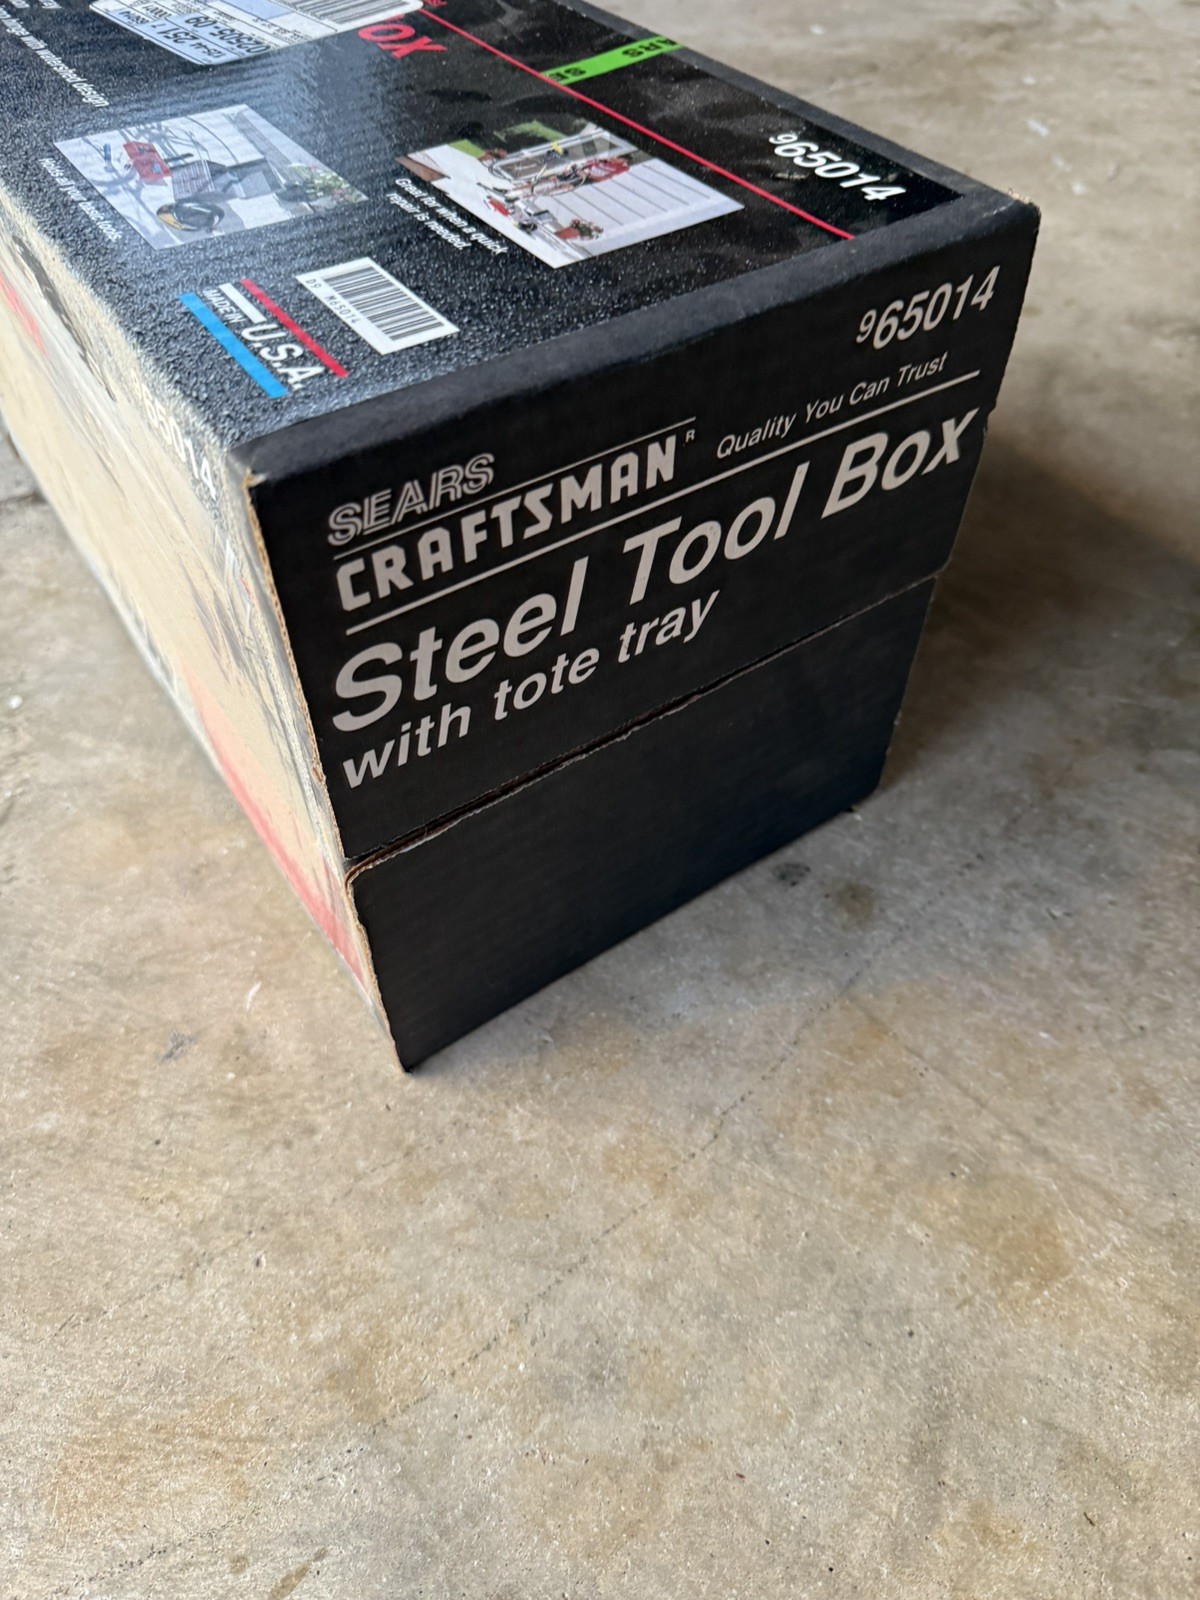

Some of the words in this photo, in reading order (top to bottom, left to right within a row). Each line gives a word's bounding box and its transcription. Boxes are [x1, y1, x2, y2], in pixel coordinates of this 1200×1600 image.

[21, 35, 48, 50] with
[35, 49, 88, 83] watershed
[72, 82, 109, 107] design
[357, 15, 447, 59] OX
[38, 157, 64, 177] Holds
[55, 176, 76, 188] all
[59, 186, 88, 202] your
[768, 131, 908, 203] 965014
[79, 200, 105, 222] basic
[386, 190, 421, 214] repair
[414, 211, 430, 222] is
[425, 220, 472, 251] needed.
[395, 178, 428, 198] Great
[420, 196, 441, 209] for
[436, 207, 469, 228] when
[462, 226, 476, 235] a
[470, 233, 508, 256] quick
[202, 287, 236, 314] MADE
[224, 311, 247, 324] IN
[857, 265, 1001, 350] 965014
[241, 323, 326, 391] U.S.A.
[717, 427, 797, 459] Quality
[805, 395, 844, 423] You
[849, 377, 890, 405] Can
[895, 351, 948, 387] Trust
[328, 453, 495, 546] SEARS
[336, 434, 677, 611] CRAFTSMAN
[332, 555, 589, 732] Steel
[622, 461, 810, 606] Tool
[821, 409, 979, 518] Box
[342, 702, 472, 789] with
[493, 647, 600, 721] tote
[617, 589, 720, 663] tray
